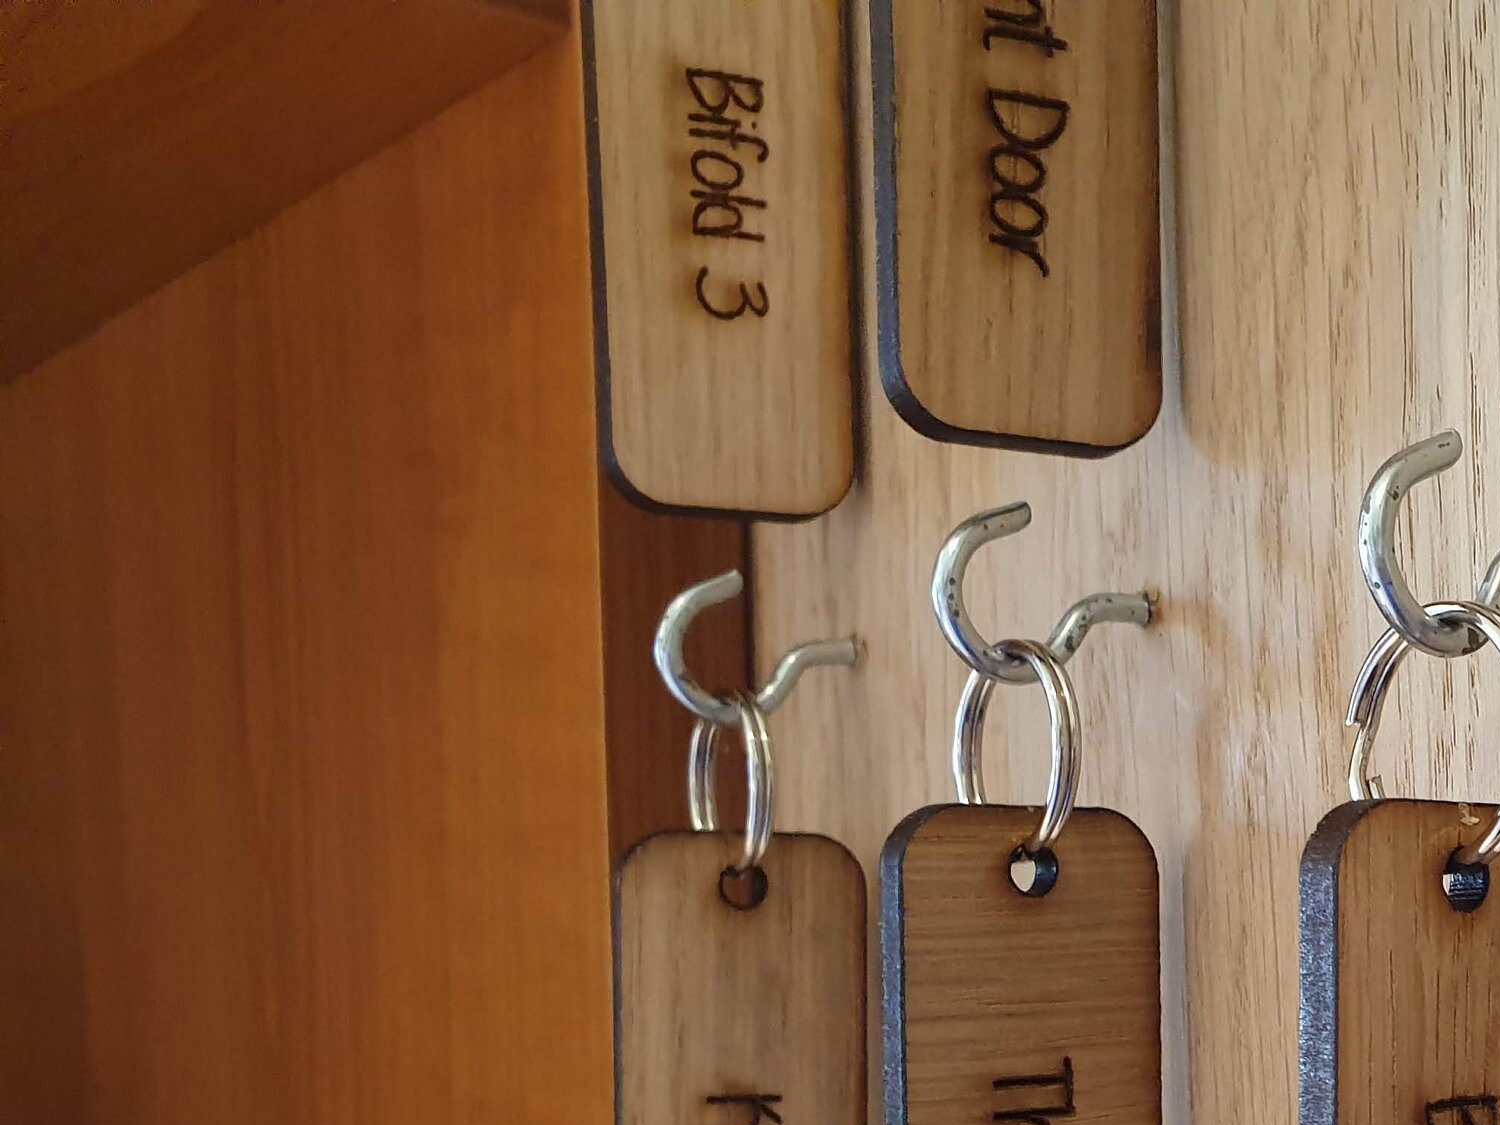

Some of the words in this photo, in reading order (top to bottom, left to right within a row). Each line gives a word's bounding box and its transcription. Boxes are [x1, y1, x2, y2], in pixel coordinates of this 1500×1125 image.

[685, 67, 769, 242] Bifold
[988, 88, 1070, 278] Door
[694, 266, 769, 321] 3
